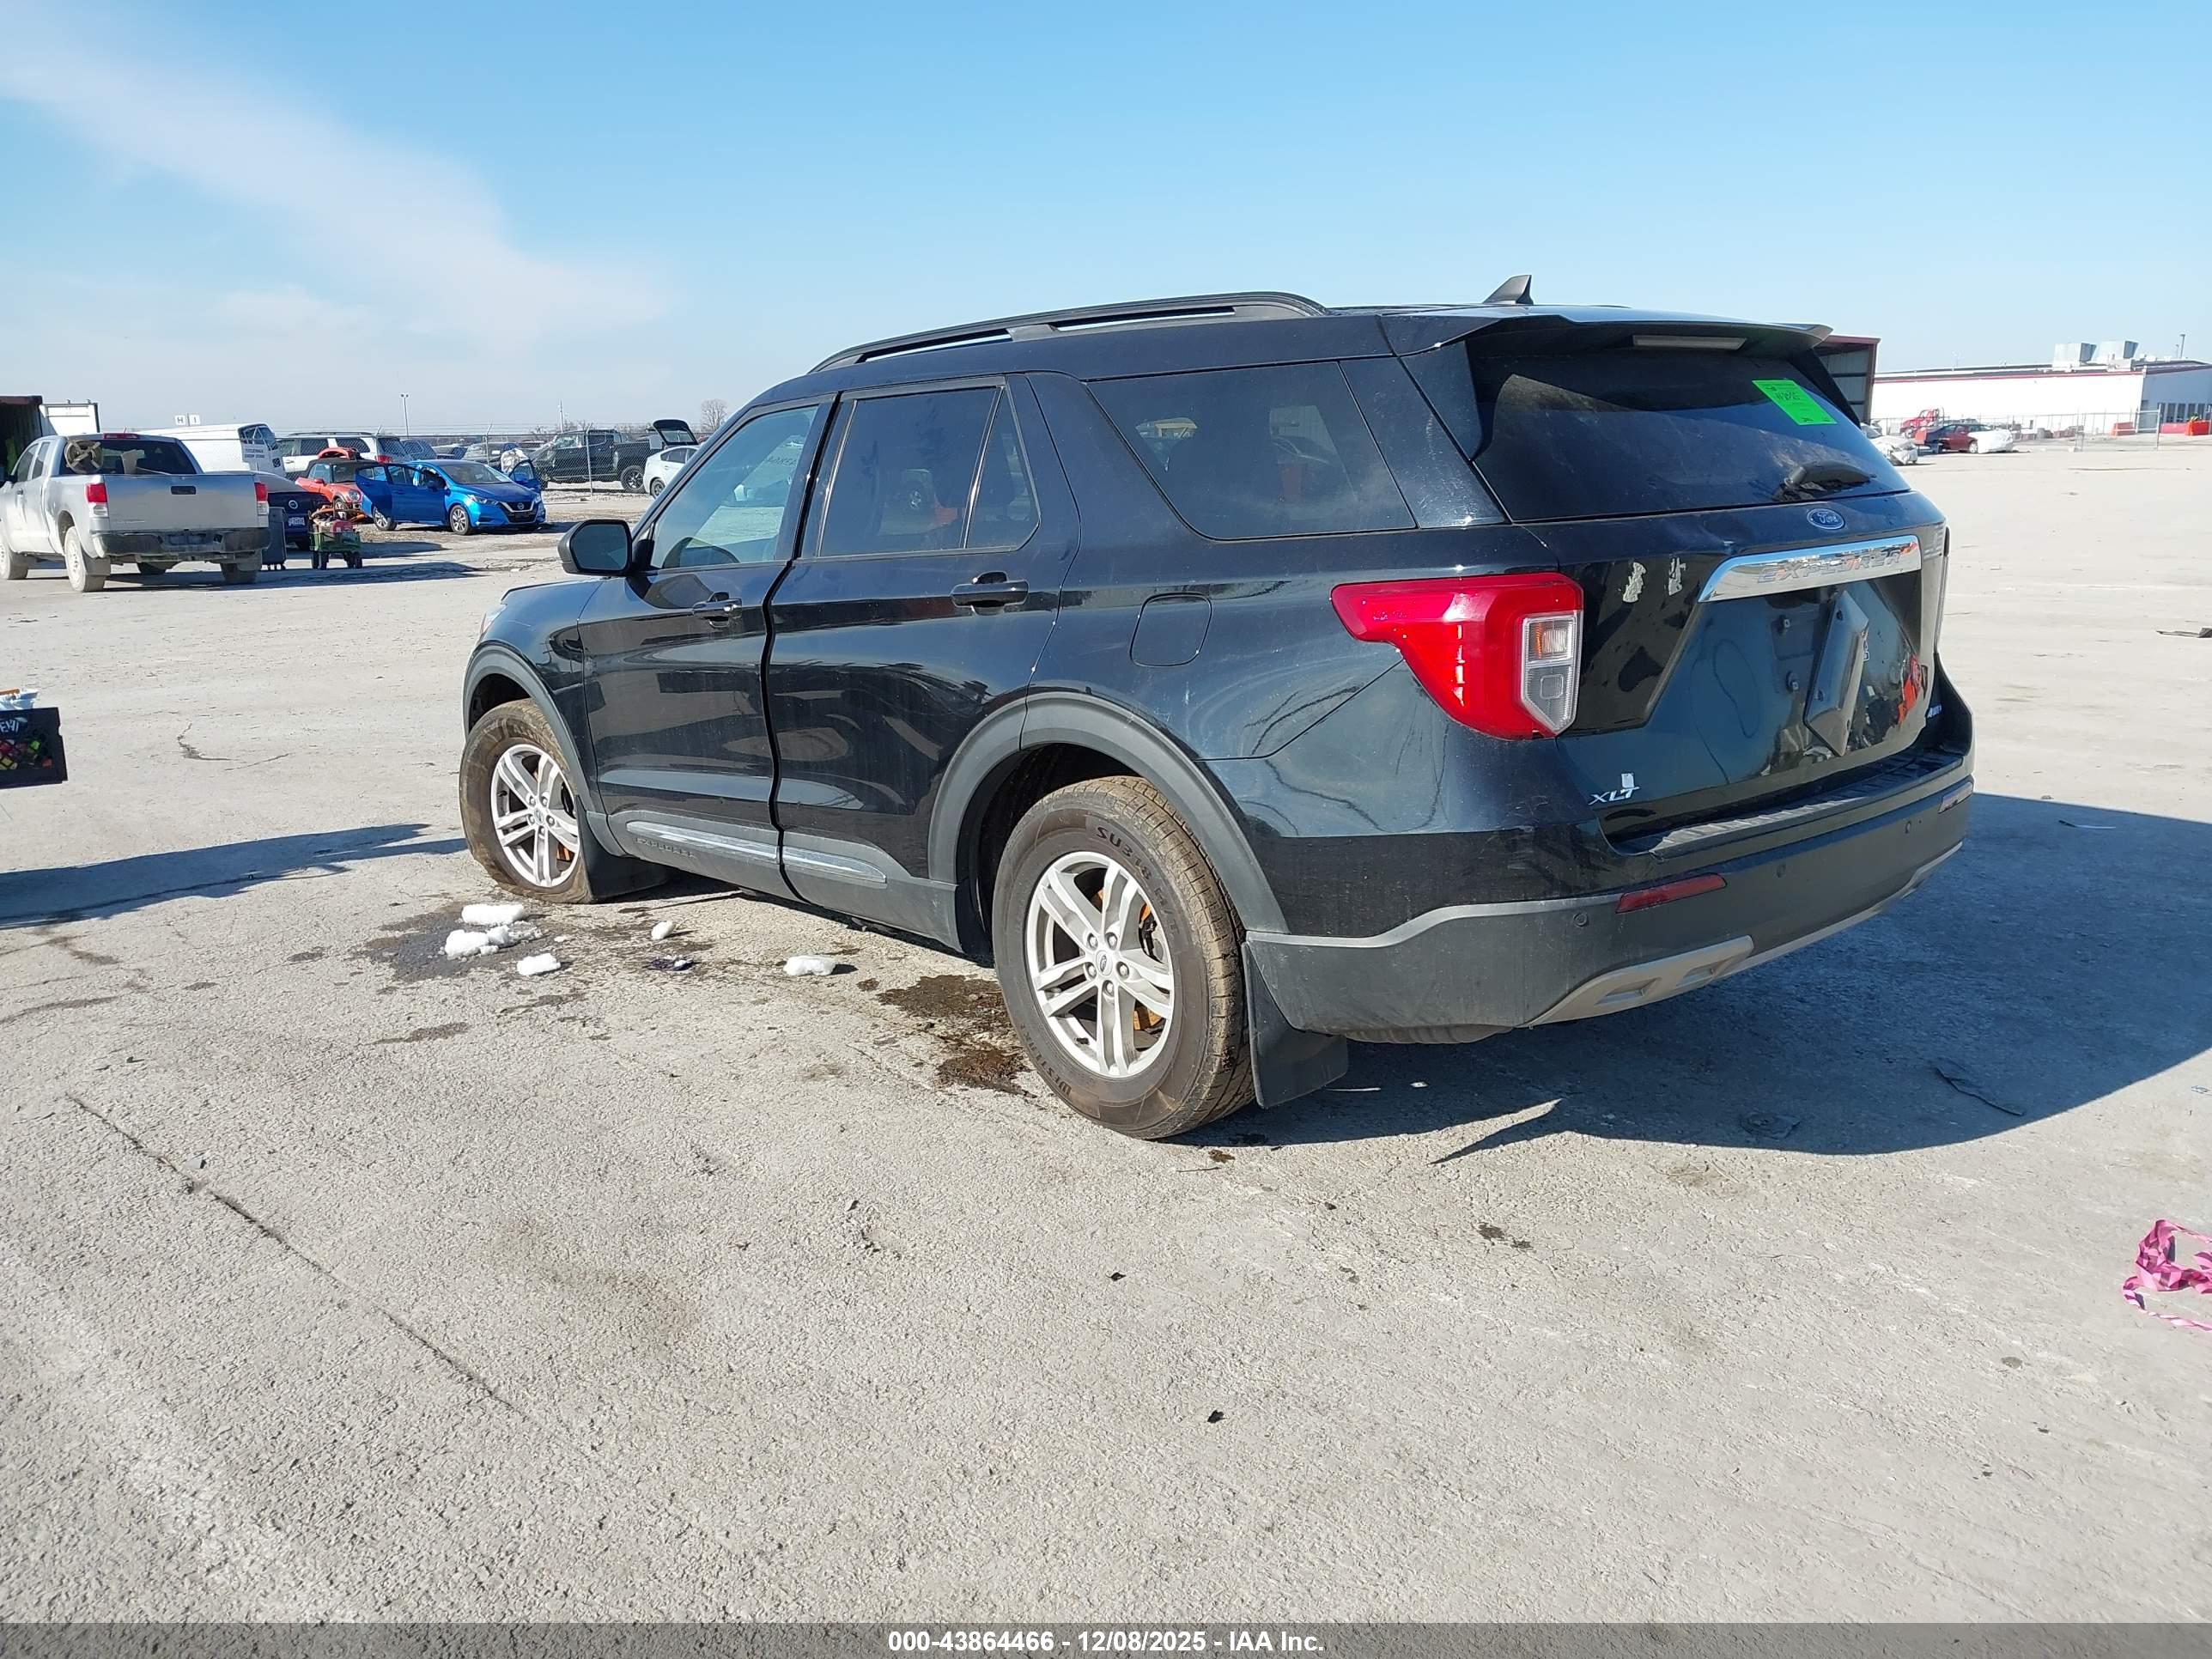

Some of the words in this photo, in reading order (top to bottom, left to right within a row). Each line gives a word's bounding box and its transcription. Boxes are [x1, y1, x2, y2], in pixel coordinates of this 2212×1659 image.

[1758, 548, 1901, 584] EXPLORER
[1588, 786, 1640, 805] XLT
[1096, 826, 1152, 880] SU318
